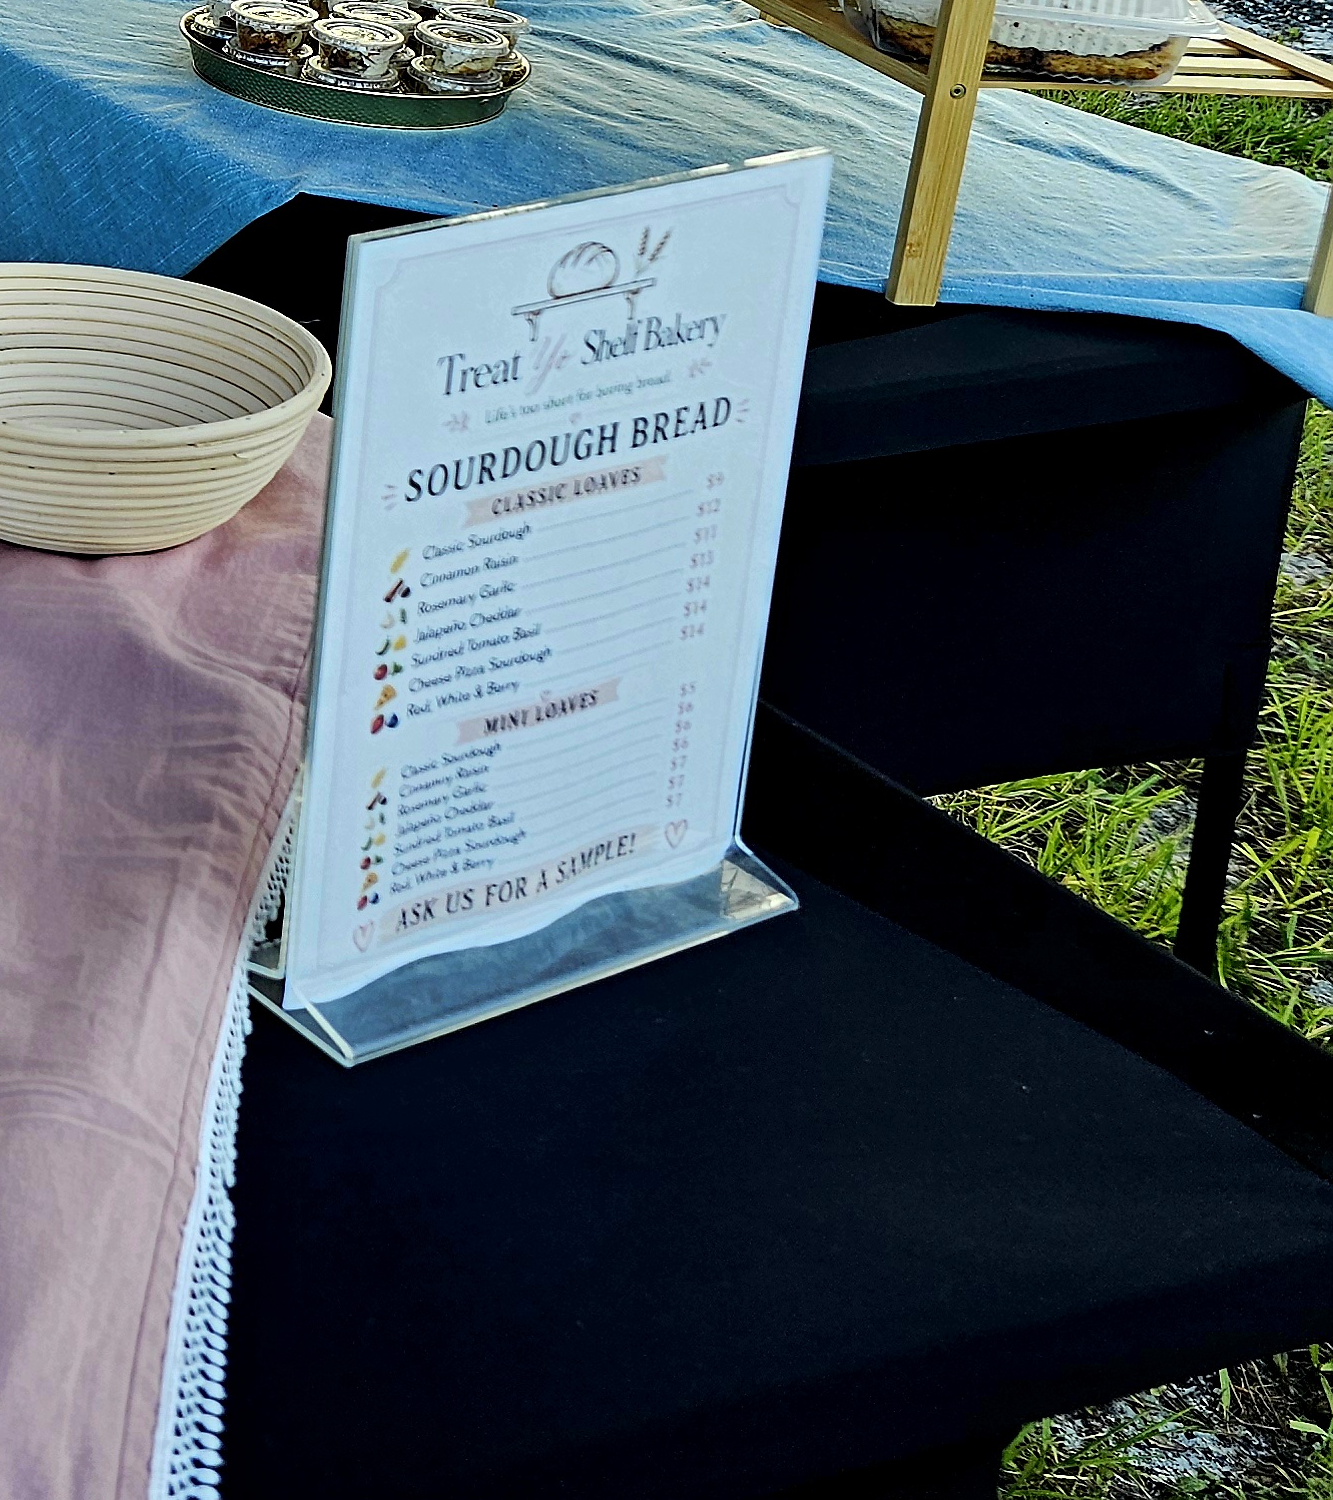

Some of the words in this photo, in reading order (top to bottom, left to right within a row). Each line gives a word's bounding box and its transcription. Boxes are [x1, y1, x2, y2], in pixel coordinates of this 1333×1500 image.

[437, 349, 523, 396] Treat
[581, 318, 642, 365] Shelf
[643, 312, 727, 351] Bakery
[404, 421, 621, 502] SOURDOUGH
[630, 397, 732, 449] BREAD
[491, 482, 568, 517] CLASSIC
[573, 466, 641, 497] LOAVES
[422, 540, 465, 561] Classic
[467, 520, 532, 548] Sourdough
[420, 564, 481, 589] Cinnamon
[483, 554, 519, 571] Raisin
[417, 591, 476, 616] Rosemary
[478, 579, 517, 599] Garlic
[469, 605, 522, 627] Cheddar
[467, 634, 510, 651] Tomato
[512, 622, 542, 641] Basil
[408, 673, 453, 693] Cheese
[454, 664, 486, 679] Pizza
[488, 645, 553, 671] Sourdough
[435, 690, 471, 709] White
[486, 679, 521, 696] Berry
[483, 708, 530, 737] MINI
[535, 688, 600, 723] LOAVES
[395, 897, 439, 933] ASK
[445, 887, 475, 914] US
[485, 875, 527, 907] FOR
[536, 868, 549, 893] A
[555, 832, 637, 884] SAMPLE!
